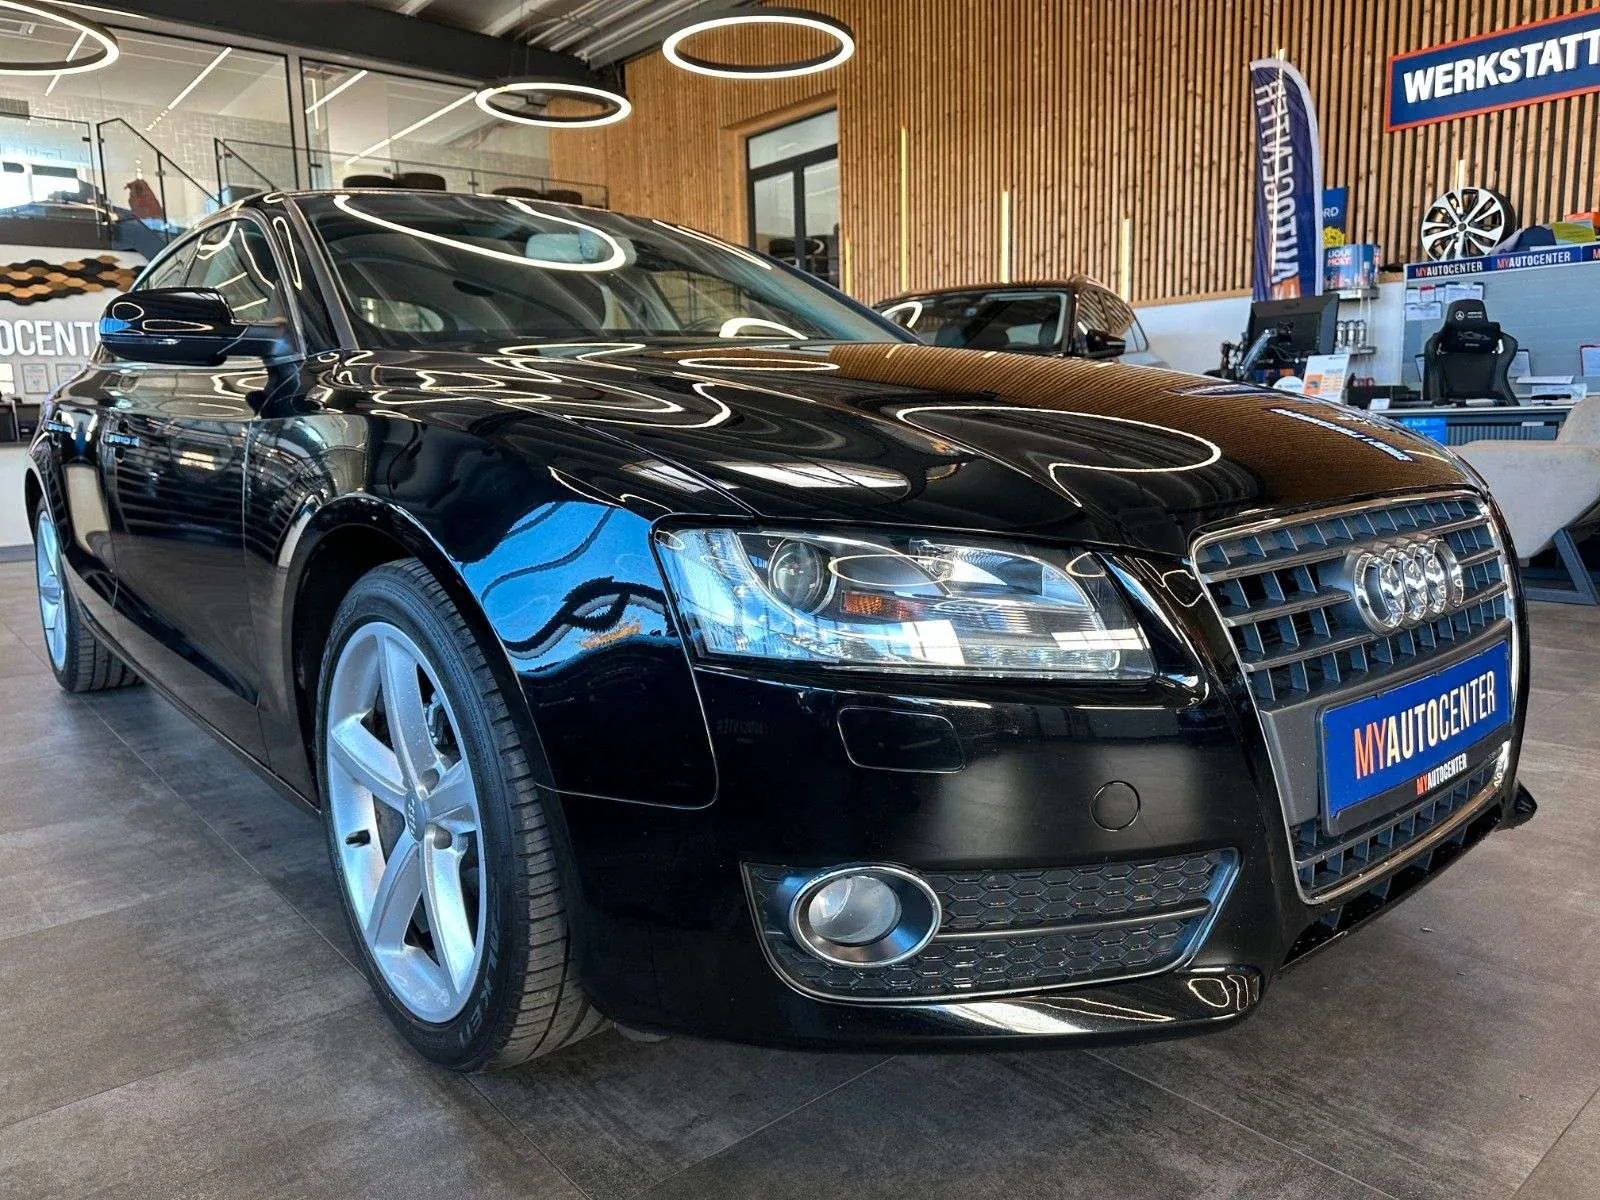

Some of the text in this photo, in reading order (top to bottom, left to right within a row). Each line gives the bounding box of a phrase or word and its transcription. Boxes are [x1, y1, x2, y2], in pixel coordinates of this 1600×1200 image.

[1403, 28, 1600, 104] WERKSTATT
[1323, 206, 1340, 218] RD
[1415, 261, 1483, 278] MYAUTOCENTER
[1497, 251, 1571, 270] MYAUTOCENTER
[0, 319, 100, 356] OCENT
[1353, 670, 1496, 780] MYAUTOCENTER
[1416, 752, 1468, 796] MYAUTOCENTER
